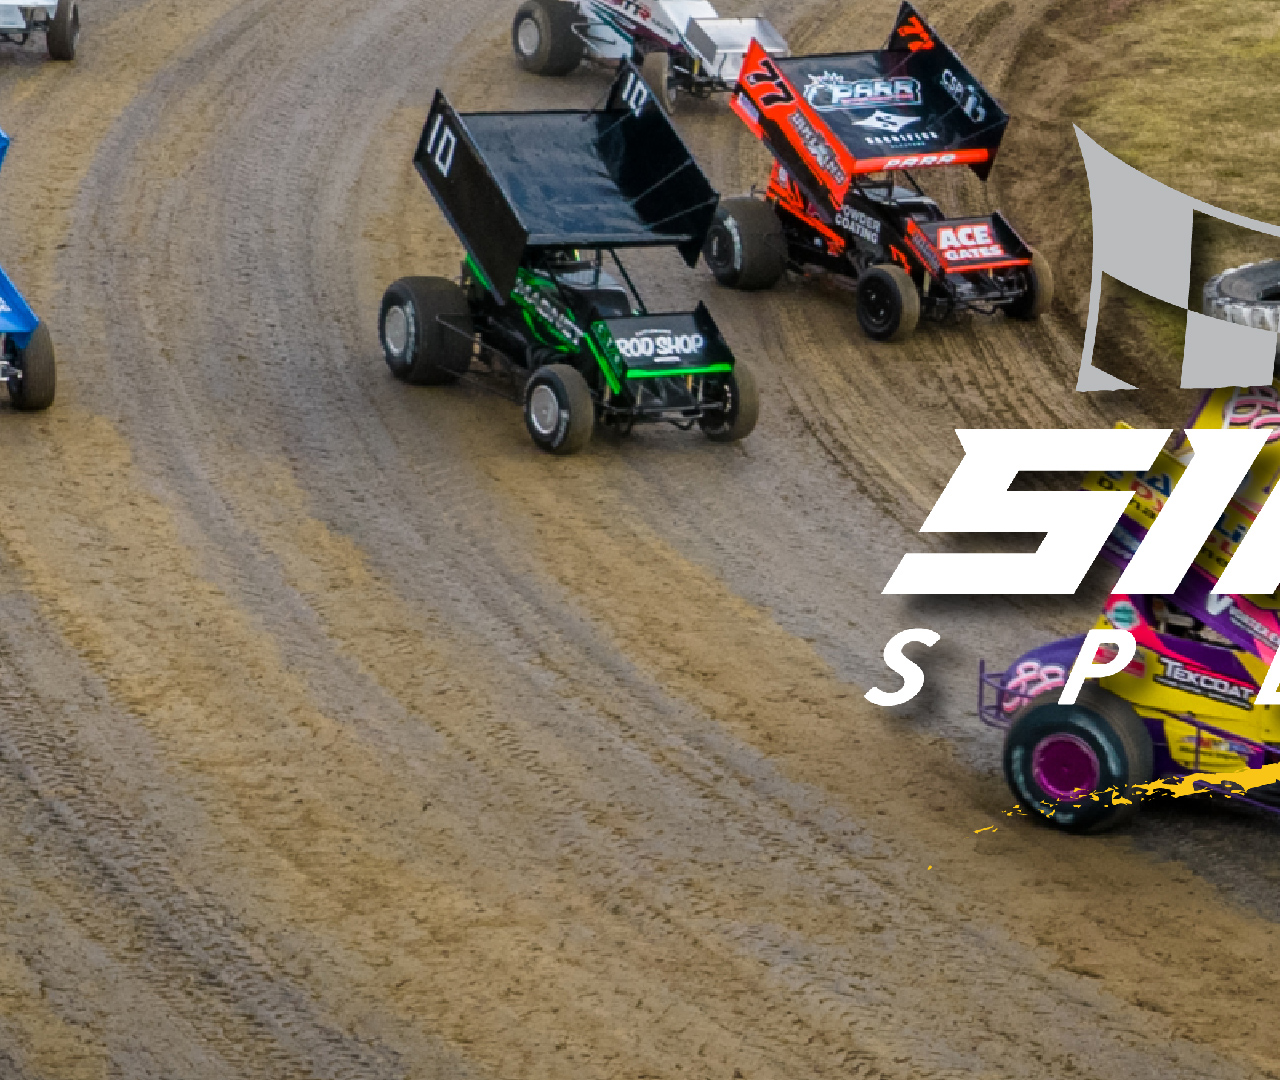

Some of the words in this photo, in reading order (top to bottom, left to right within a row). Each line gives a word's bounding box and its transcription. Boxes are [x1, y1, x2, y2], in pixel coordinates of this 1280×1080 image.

[622, 72, 648, 118] 10
[745, 57, 797, 109] 77
[426, 113, 458, 178] 10
[834, 212, 878, 245] COATING
[840, 204, 881, 233] OWDER
[939, 224, 991, 250] ACE
[615, 337, 655, 357] ROD
[656, 333, 704, 355] SHOP
